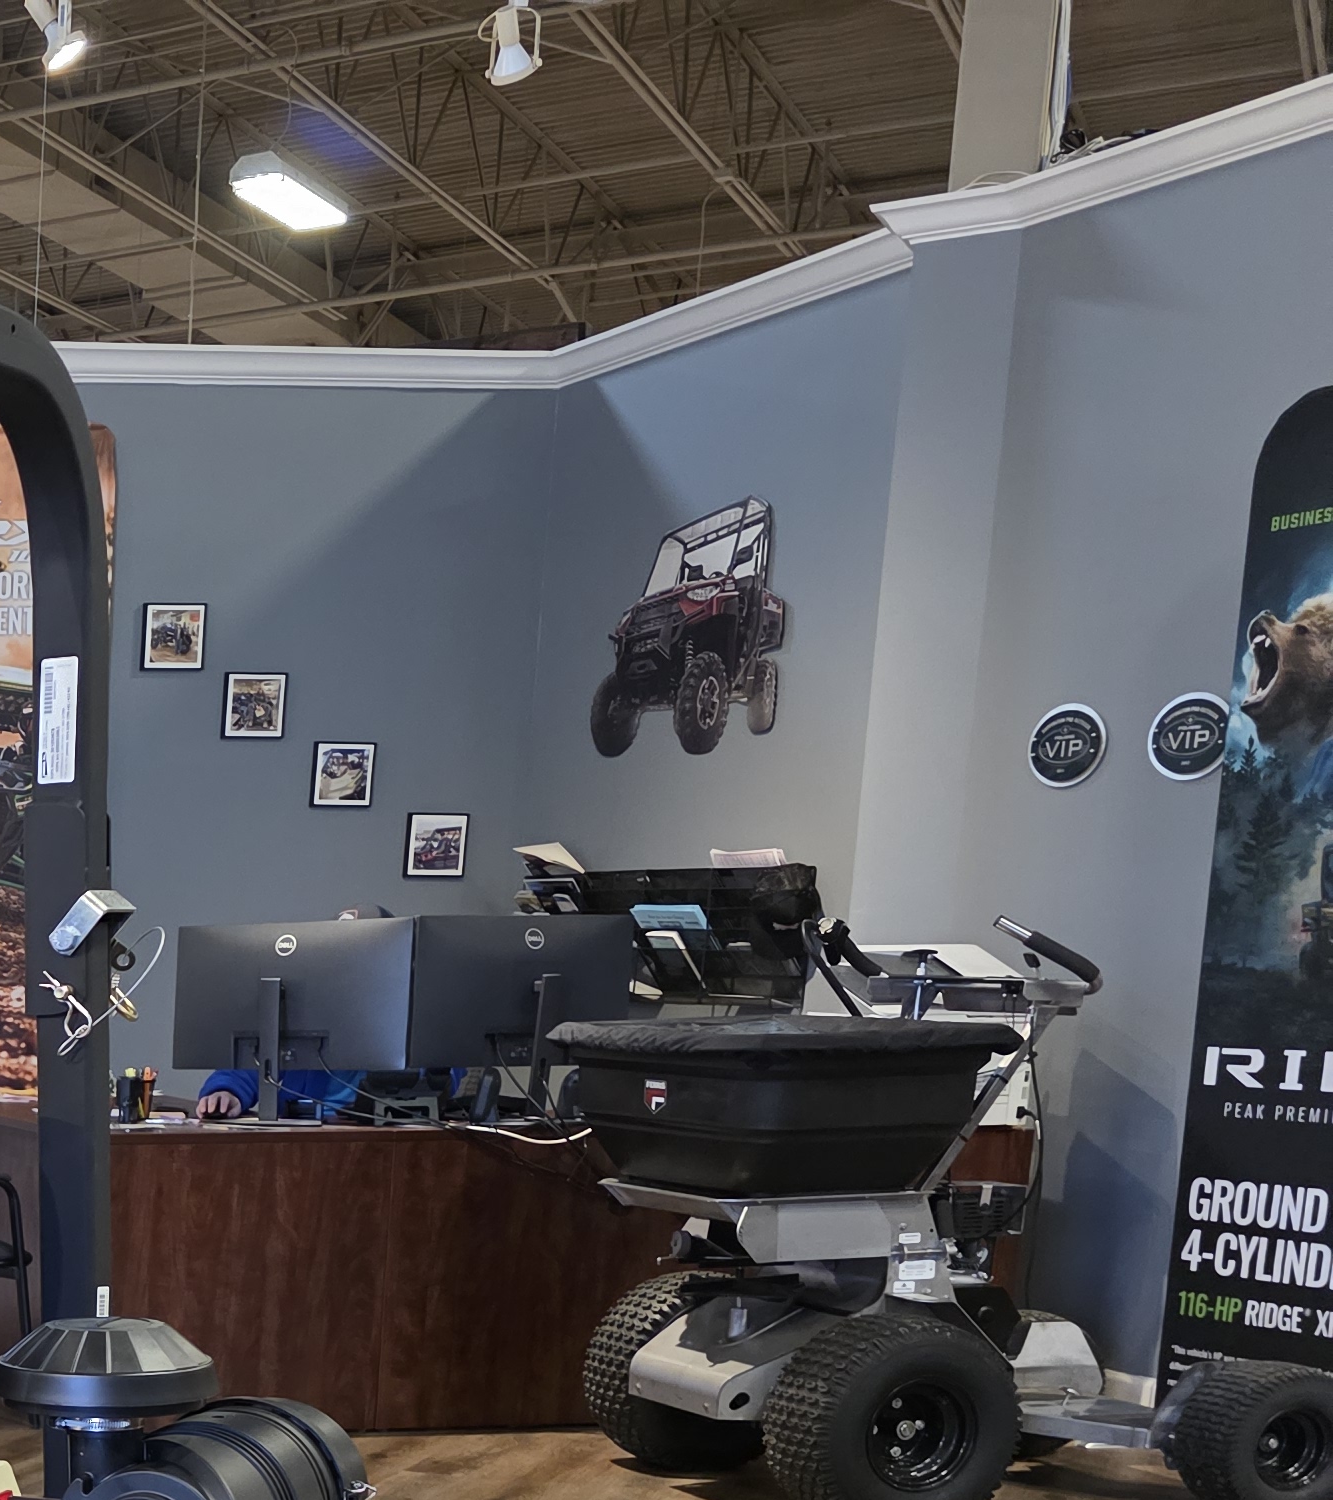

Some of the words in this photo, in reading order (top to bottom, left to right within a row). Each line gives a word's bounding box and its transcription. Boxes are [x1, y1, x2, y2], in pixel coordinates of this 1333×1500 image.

[1045, 739, 1083, 759] VIP
[1168, 730, 1210, 750] VIP
[1203, 1046, 1333, 1093] RI
[1223, 1102, 1265, 1121] PEAK
[1188, 1176, 1329, 1234] GROUND
[1178, 1290, 1242, 1324] 116-HP
